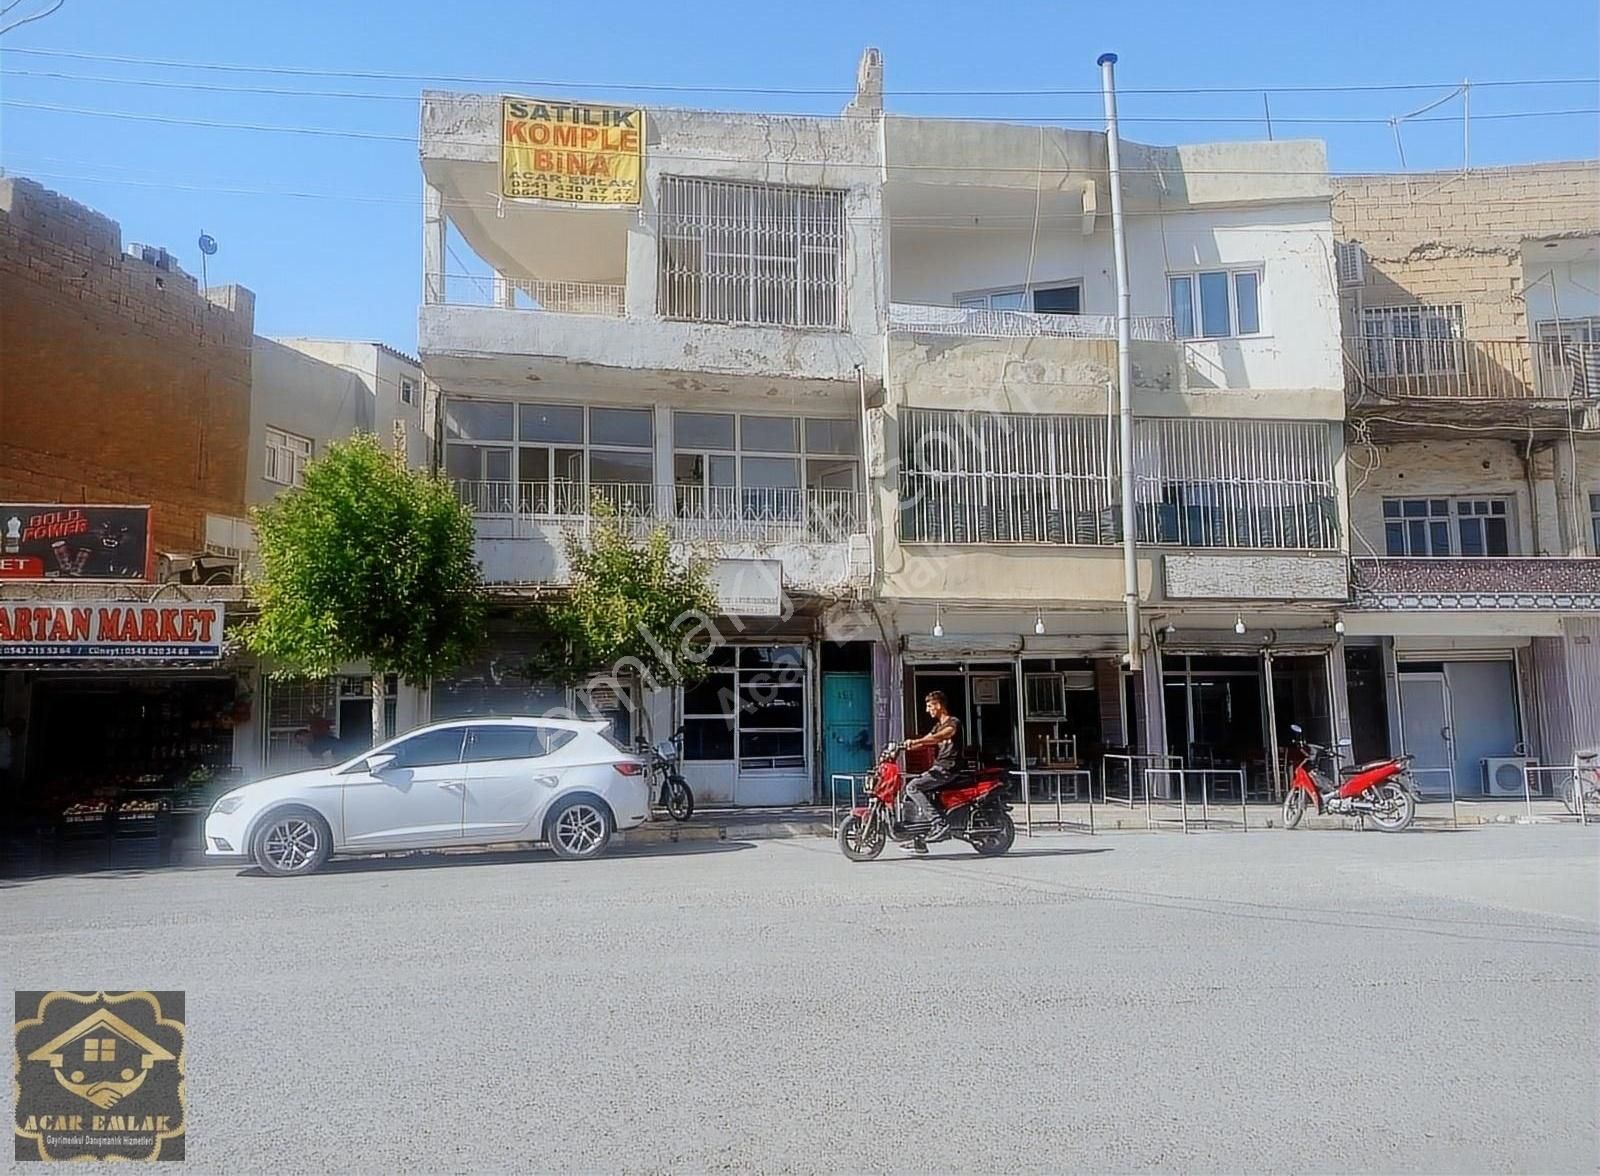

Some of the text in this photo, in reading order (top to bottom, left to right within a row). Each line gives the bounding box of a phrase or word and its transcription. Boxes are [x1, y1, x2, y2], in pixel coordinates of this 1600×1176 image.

[505, 119, 638, 152] KOMPLE
[509, 171, 634, 188] ACAR EMLAK
[511, 180, 548, 190] 0541
[555, 184, 583, 193] 430
[511, 188, 548, 198] 0541
[22, 519, 88, 543] POWER
[97, 608, 216, 643] MARKET
